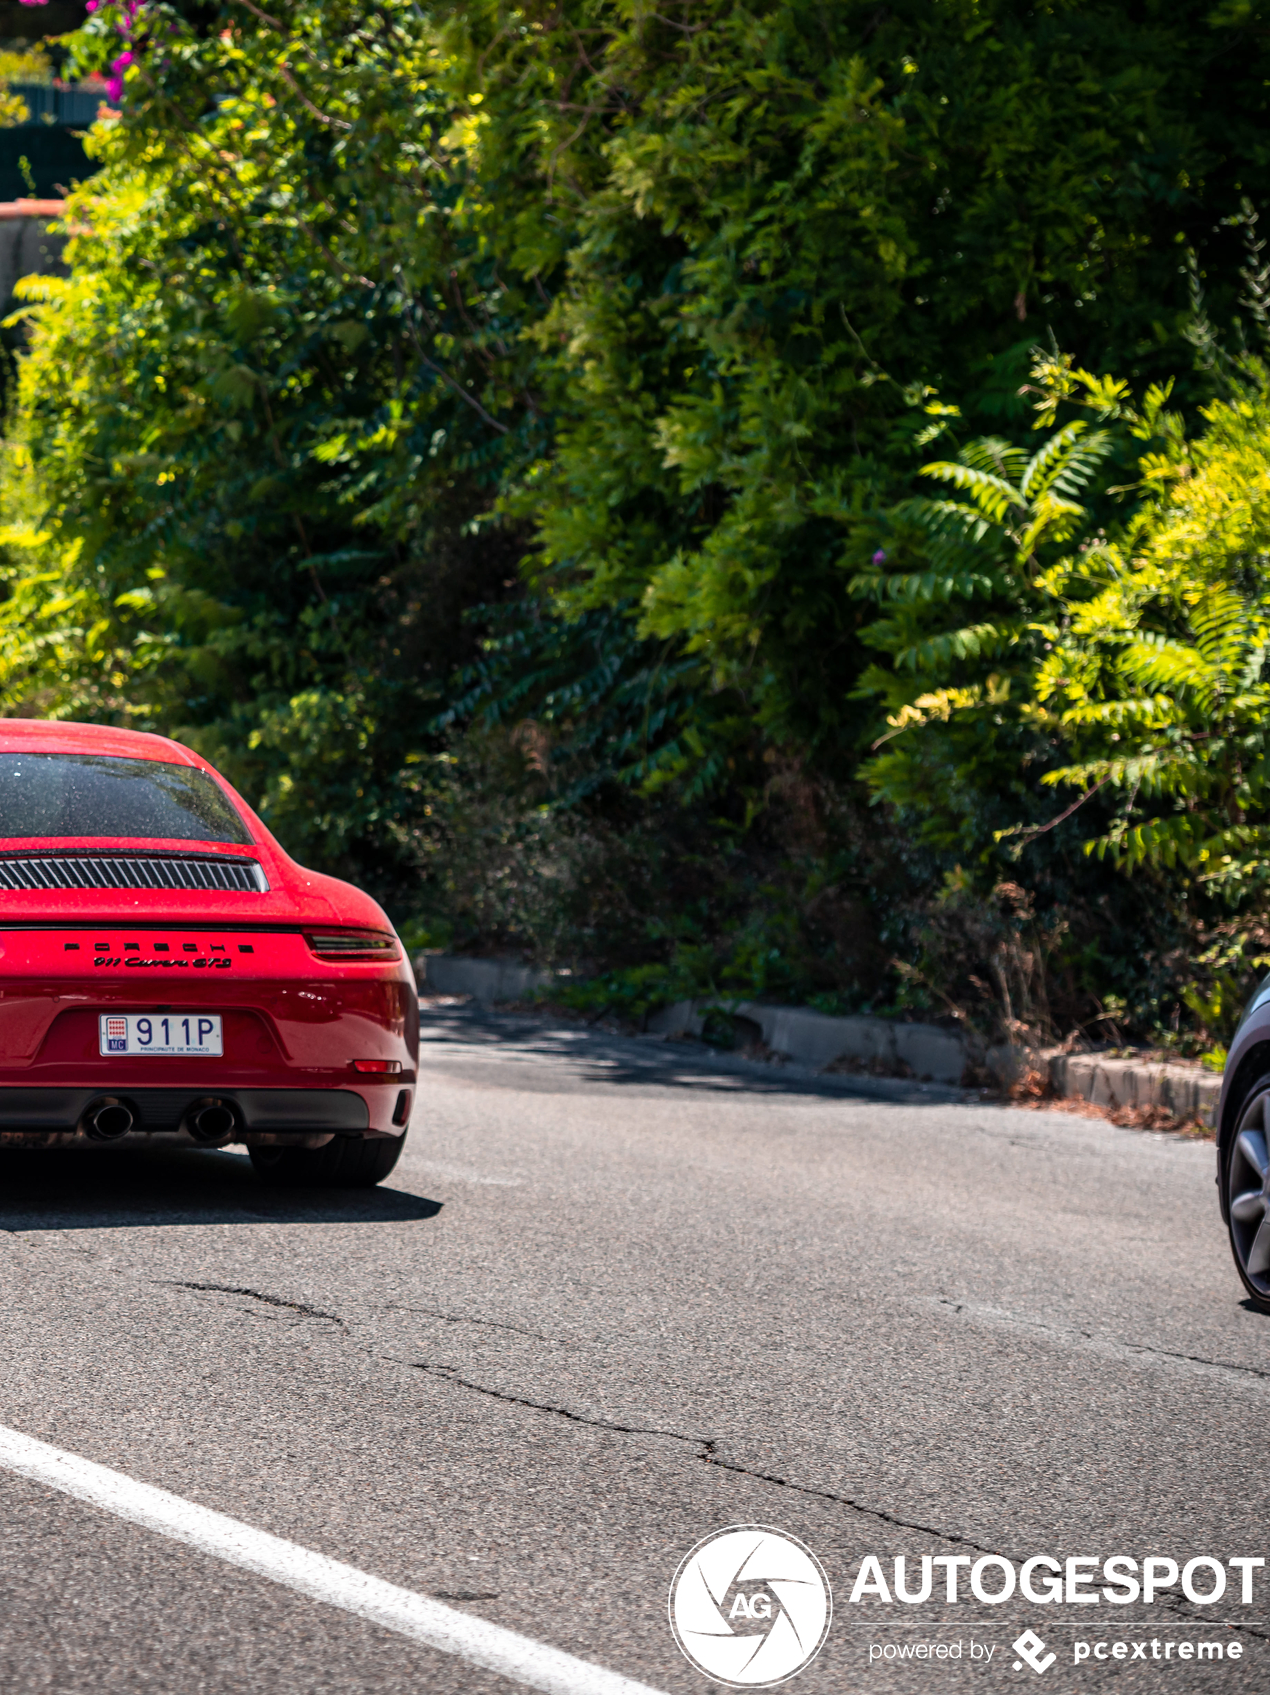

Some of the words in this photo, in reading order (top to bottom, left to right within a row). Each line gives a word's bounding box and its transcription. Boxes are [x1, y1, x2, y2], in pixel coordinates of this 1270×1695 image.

[64, 943, 255, 953] PORSCHE
[136, 1018, 214, 1046] 911P
[111, 1040, 124, 1050] MC
